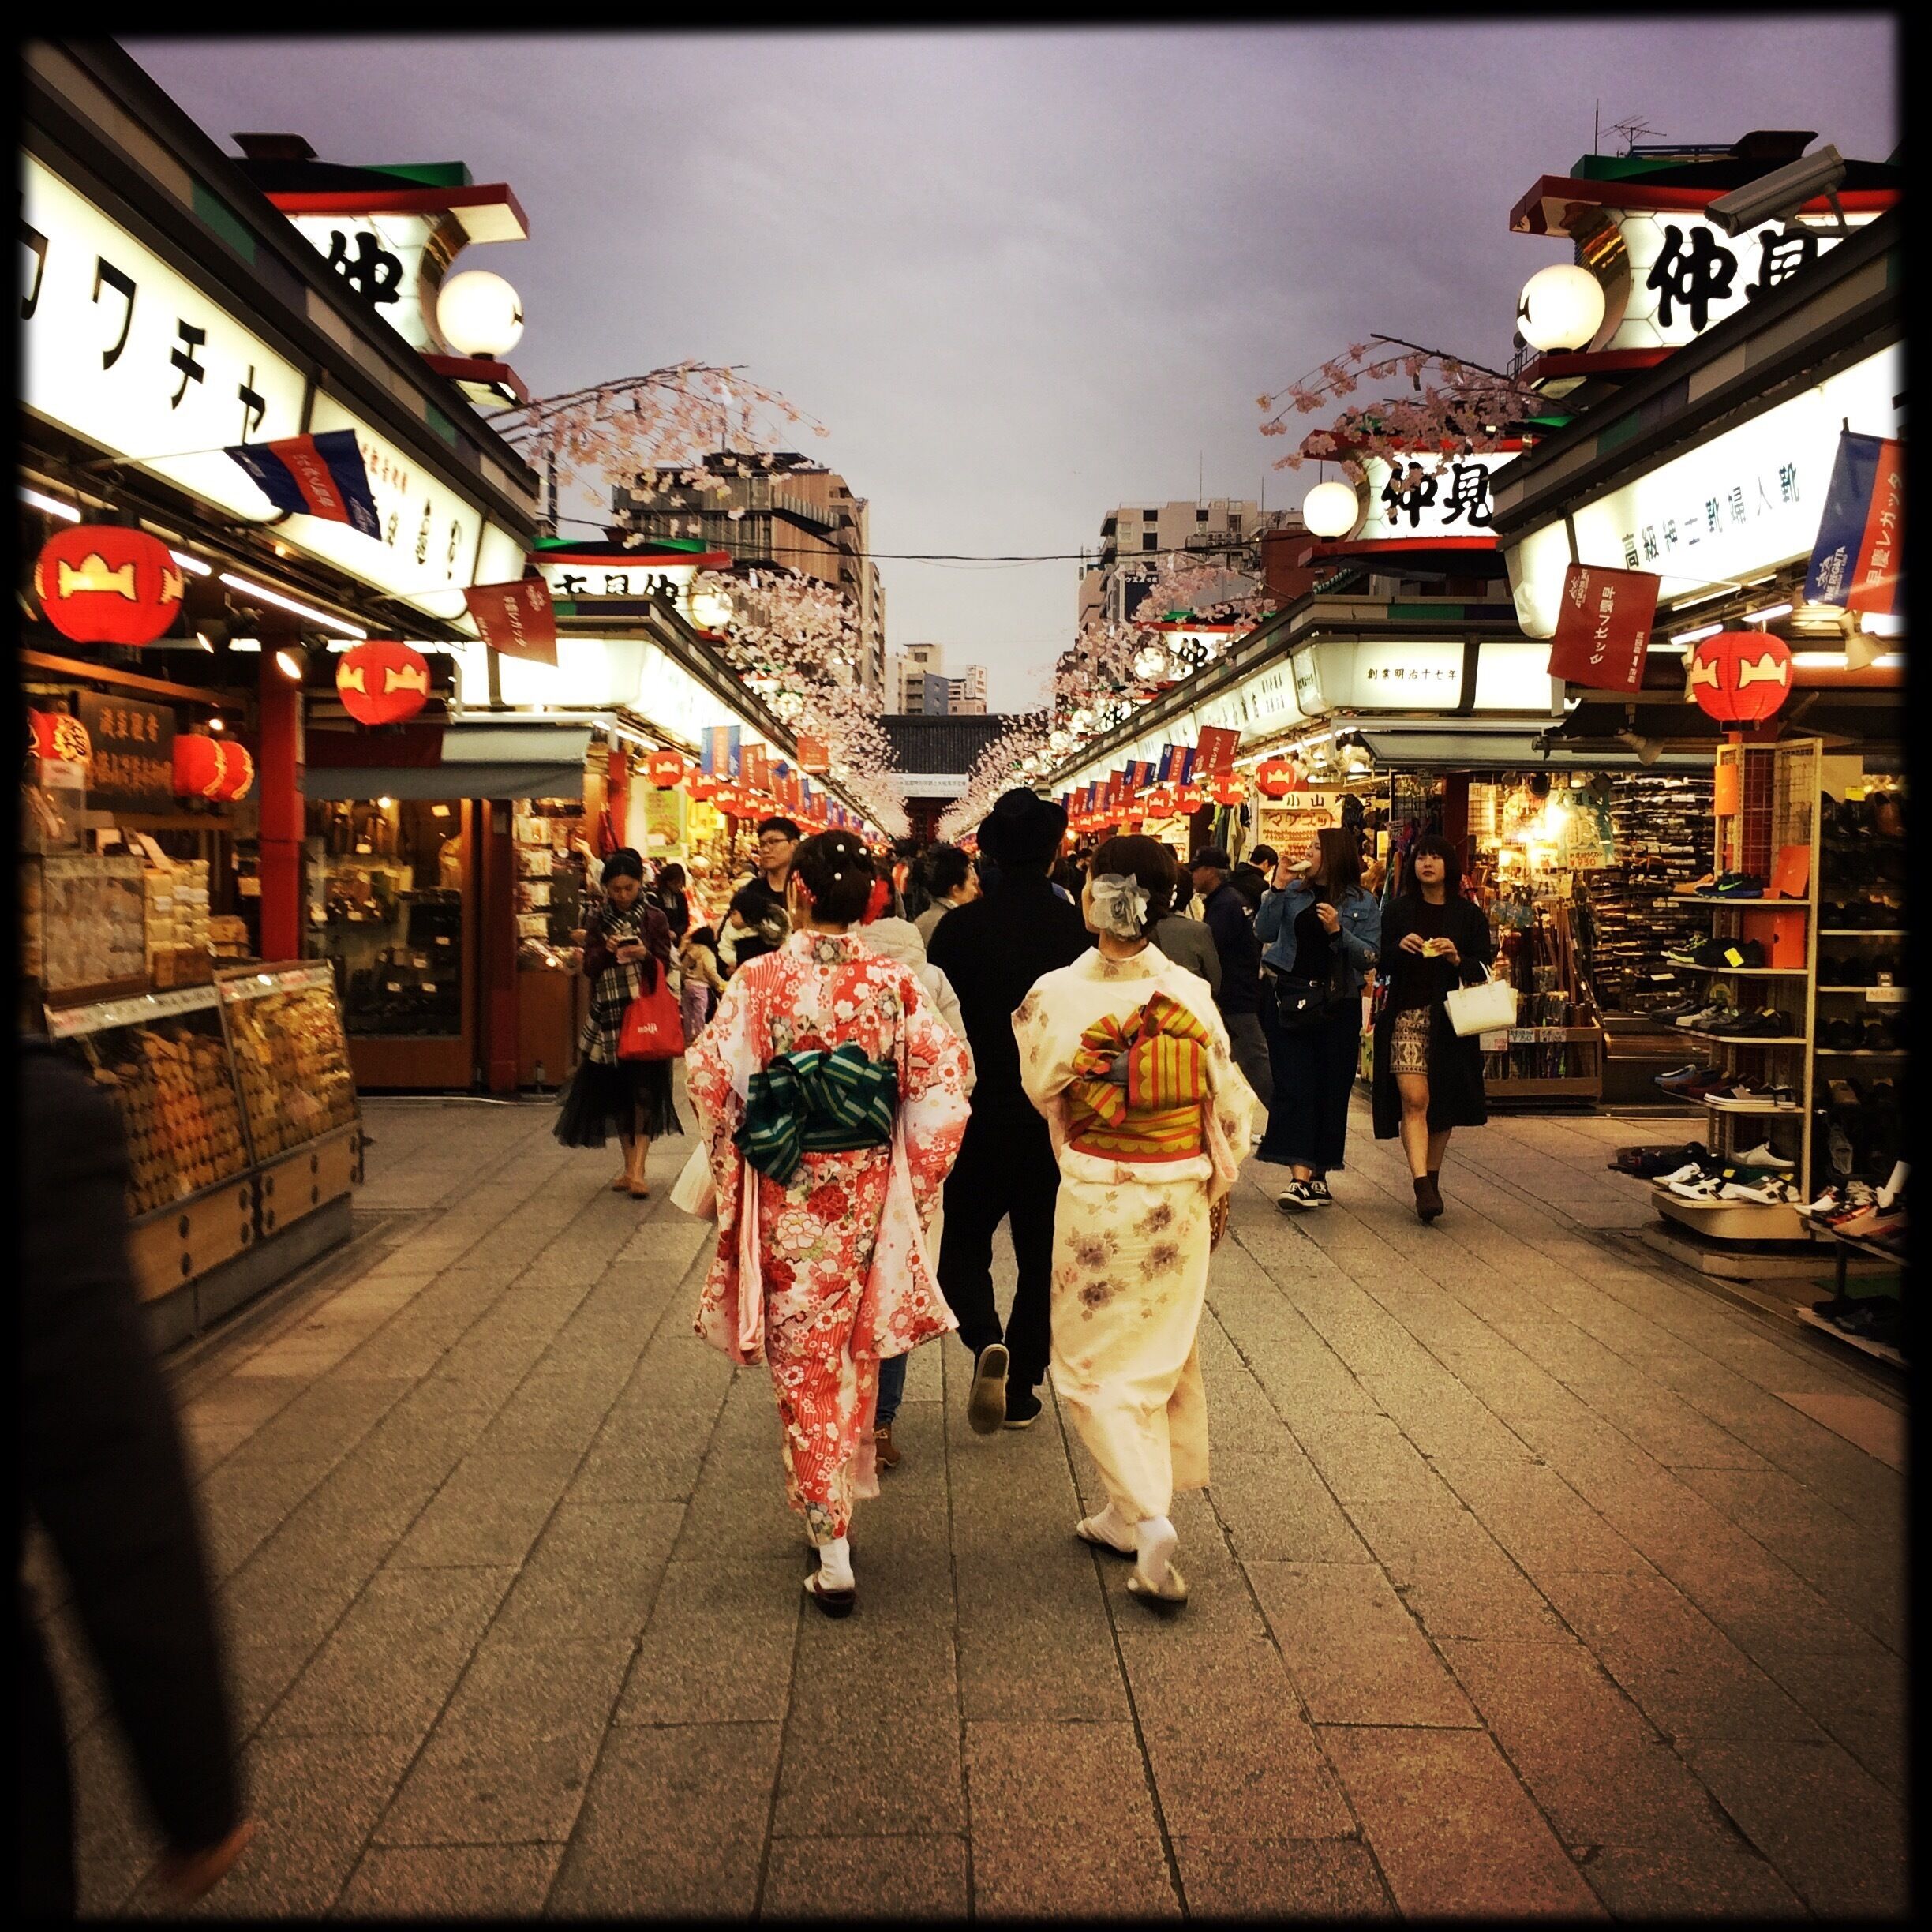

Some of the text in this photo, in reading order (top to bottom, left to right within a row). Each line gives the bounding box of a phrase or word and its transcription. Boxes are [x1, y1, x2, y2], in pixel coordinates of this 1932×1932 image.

[1866, 472, 1903, 587] 早慶レガッタ
[1367, 668, 1457, 680] 創業明治十七年
